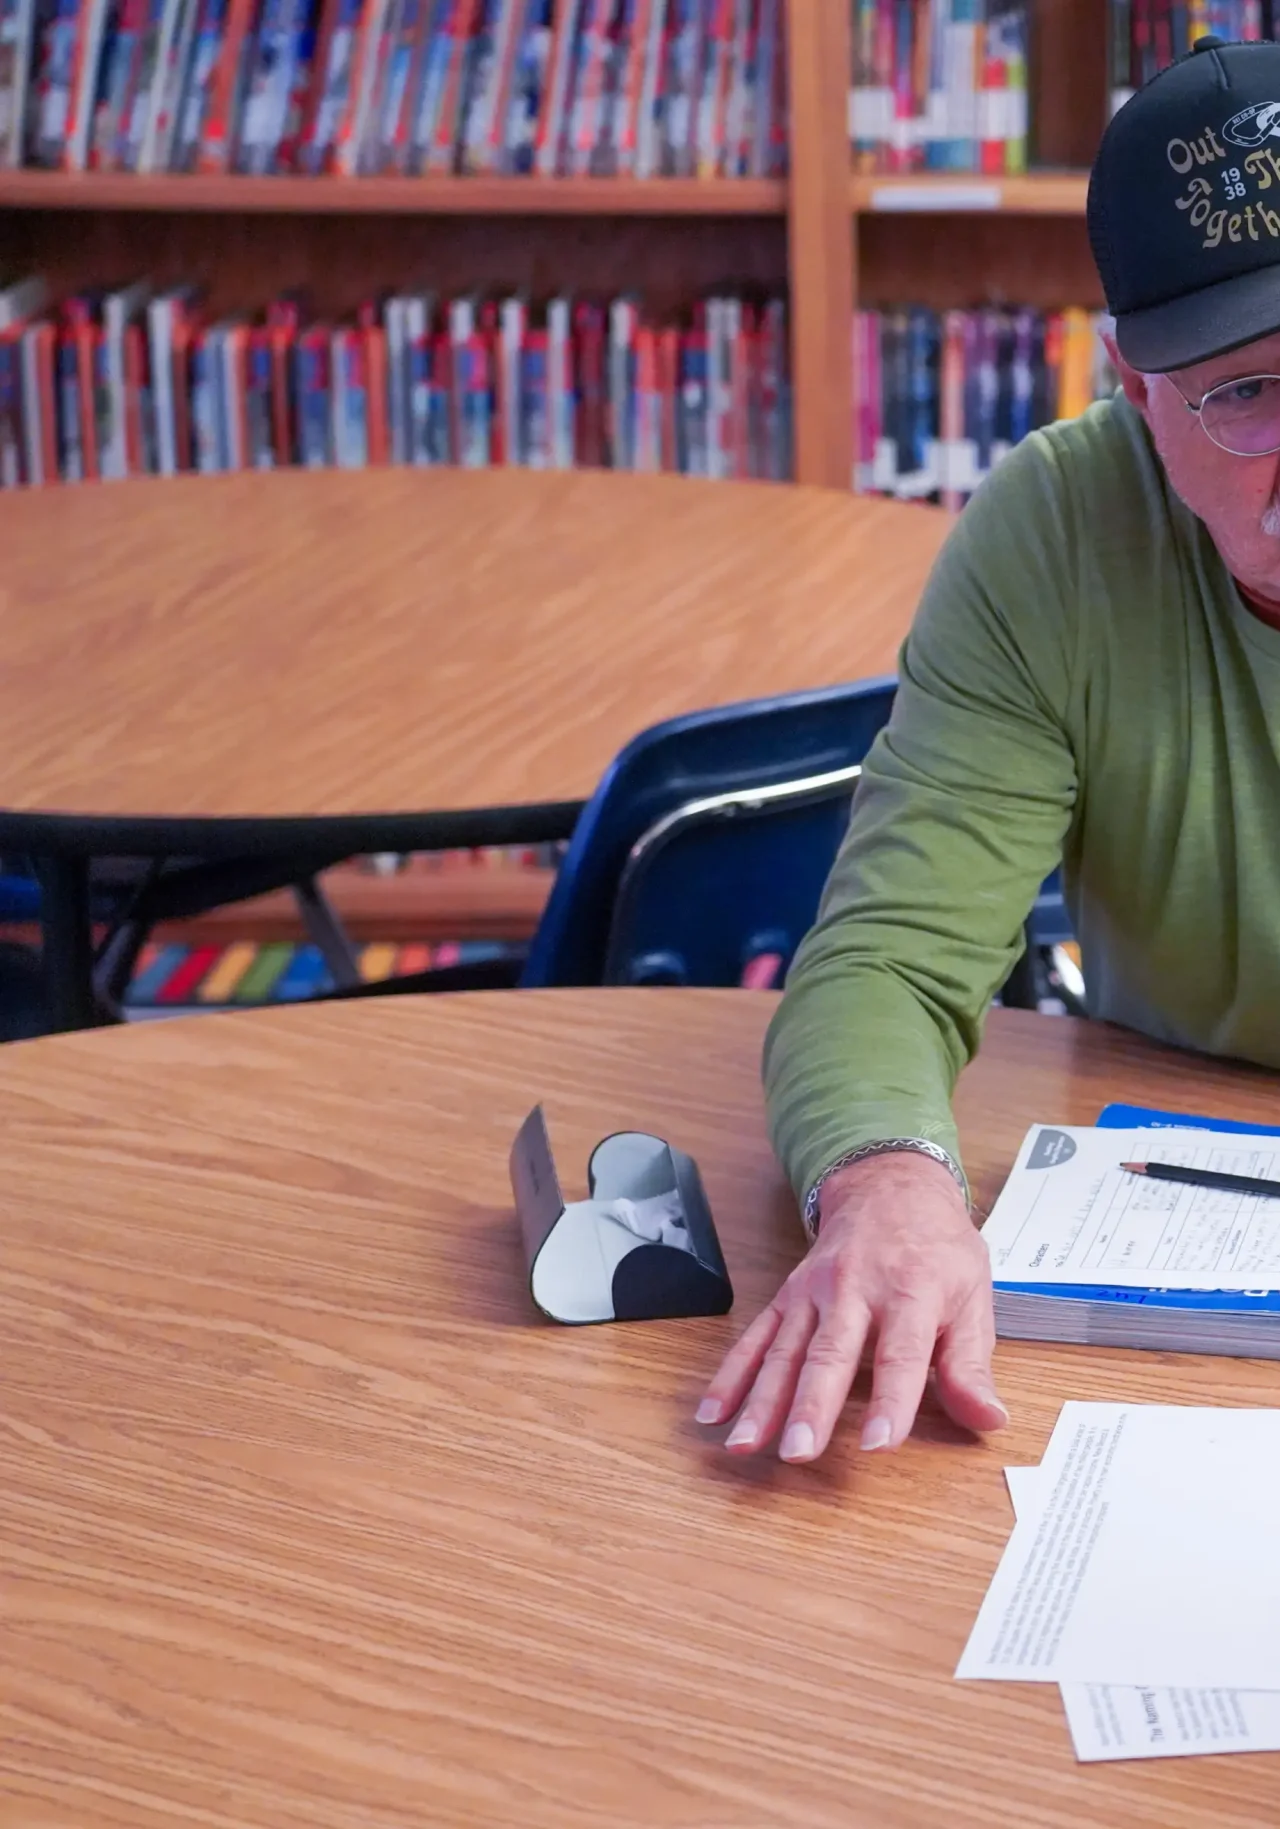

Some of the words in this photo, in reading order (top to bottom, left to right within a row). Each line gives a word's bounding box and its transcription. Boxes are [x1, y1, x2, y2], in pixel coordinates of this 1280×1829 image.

[1167, 126, 1226, 174] Out
[1221, 167, 1241, 185] 19
[1224, 182, 1246, 200] 38
[1029, 1243, 1050, 1268] Characters
